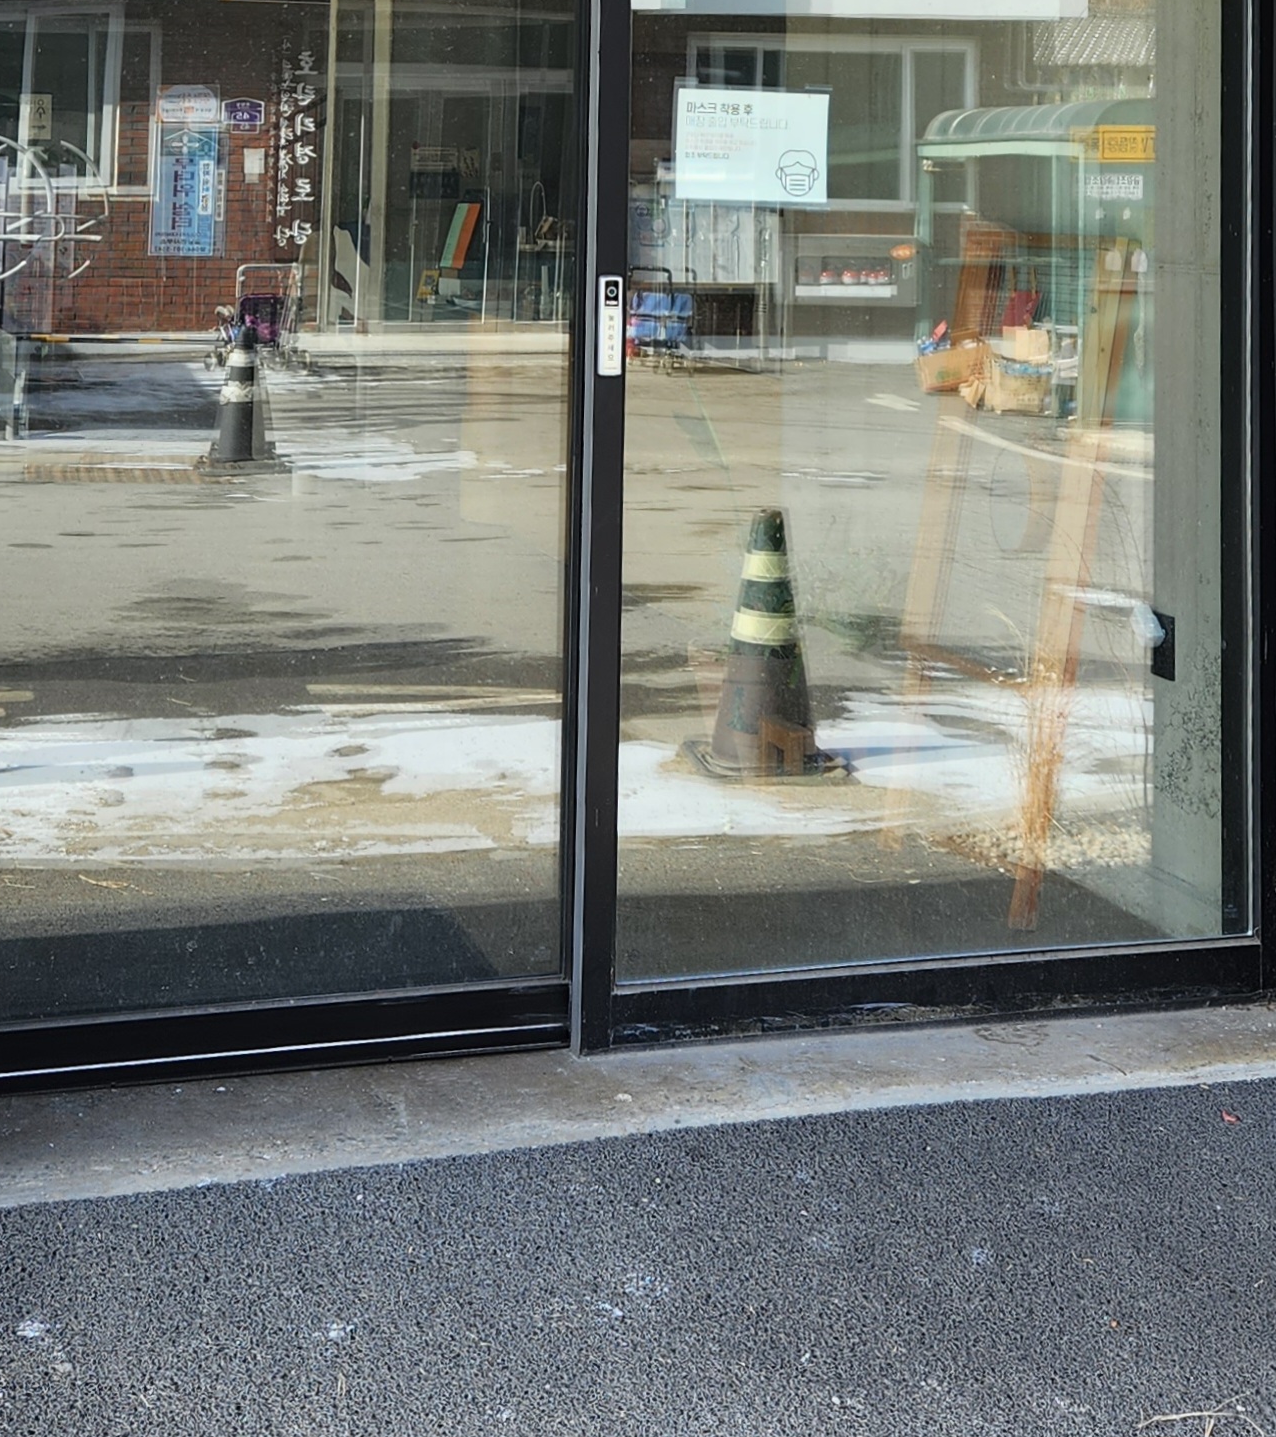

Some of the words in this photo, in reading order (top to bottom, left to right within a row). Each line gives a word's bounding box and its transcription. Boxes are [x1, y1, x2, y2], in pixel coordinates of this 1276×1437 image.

[686, 101, 717, 114] 마스크
[720, 102, 740, 115] 착용
[743, 103, 753, 115] 후
